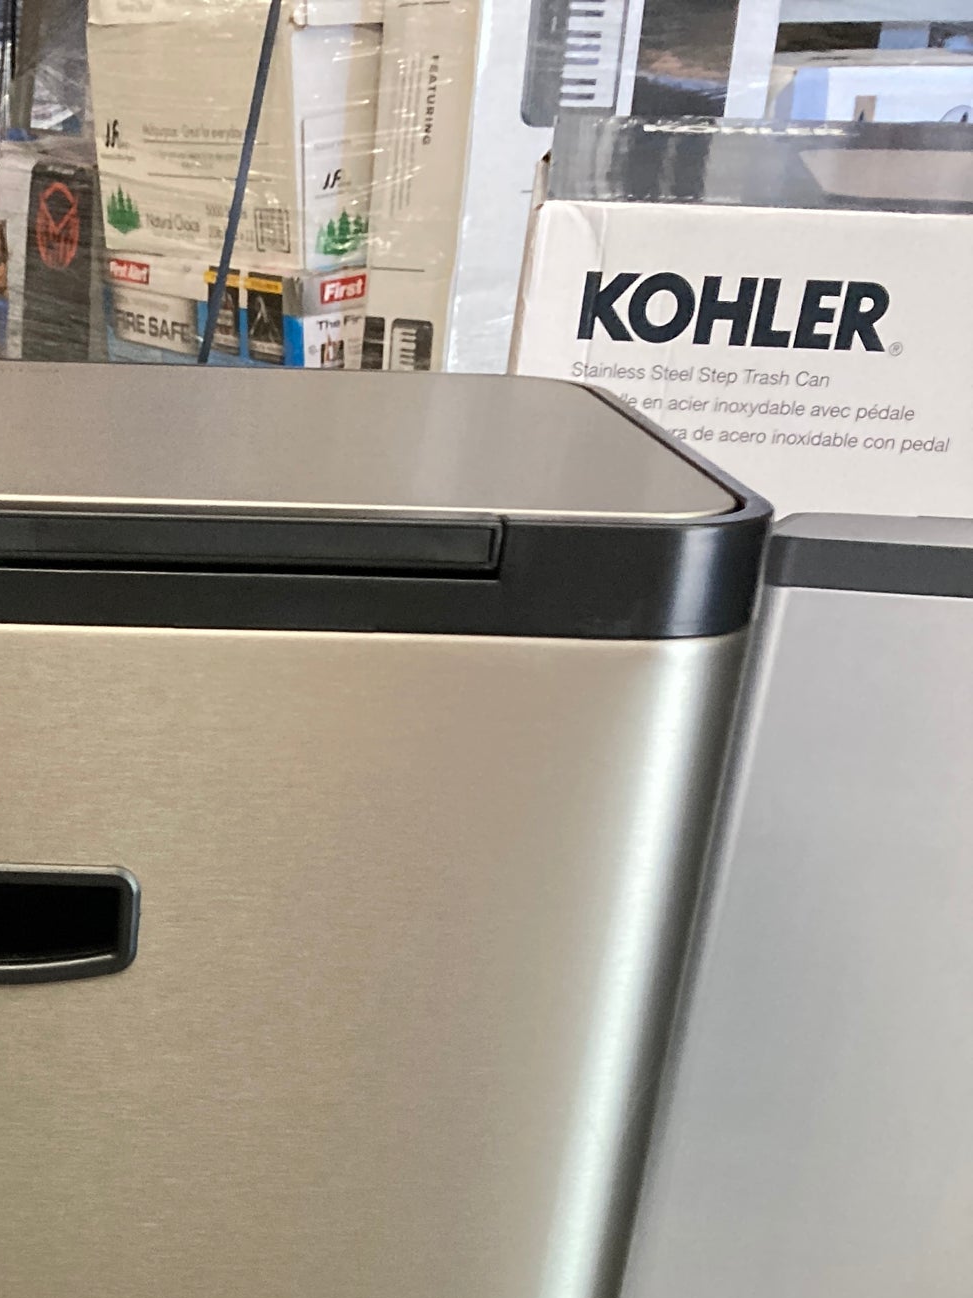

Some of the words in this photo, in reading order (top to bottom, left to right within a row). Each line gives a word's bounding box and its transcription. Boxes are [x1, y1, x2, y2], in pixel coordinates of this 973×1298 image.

[422, 55, 439, 145] FEATURING
[323, 278, 365, 302] First
[317, 318, 341, 331] The
[577, 271, 890, 352] KOHLER
[572, 361, 646, 380] Stainless
[651, 364, 694, 381] Steel
[698, 366, 738, 386] Step
[744, 369, 790, 386] Trash
[795, 370, 830, 387] Can
[642, 399, 663, 410] en
[668, 397, 709, 412] acier
[714, 397, 806, 418] inoxydable
[810, 405, 851, 419] avec
[855, 404, 915, 422] pédale
[693, 426, 714, 441] de
[719, 430, 767, 444] acero
[771, 429, 859, 448] inoxidable
[863, 436, 895, 450] con
[900, 436, 950, 454] pedal
